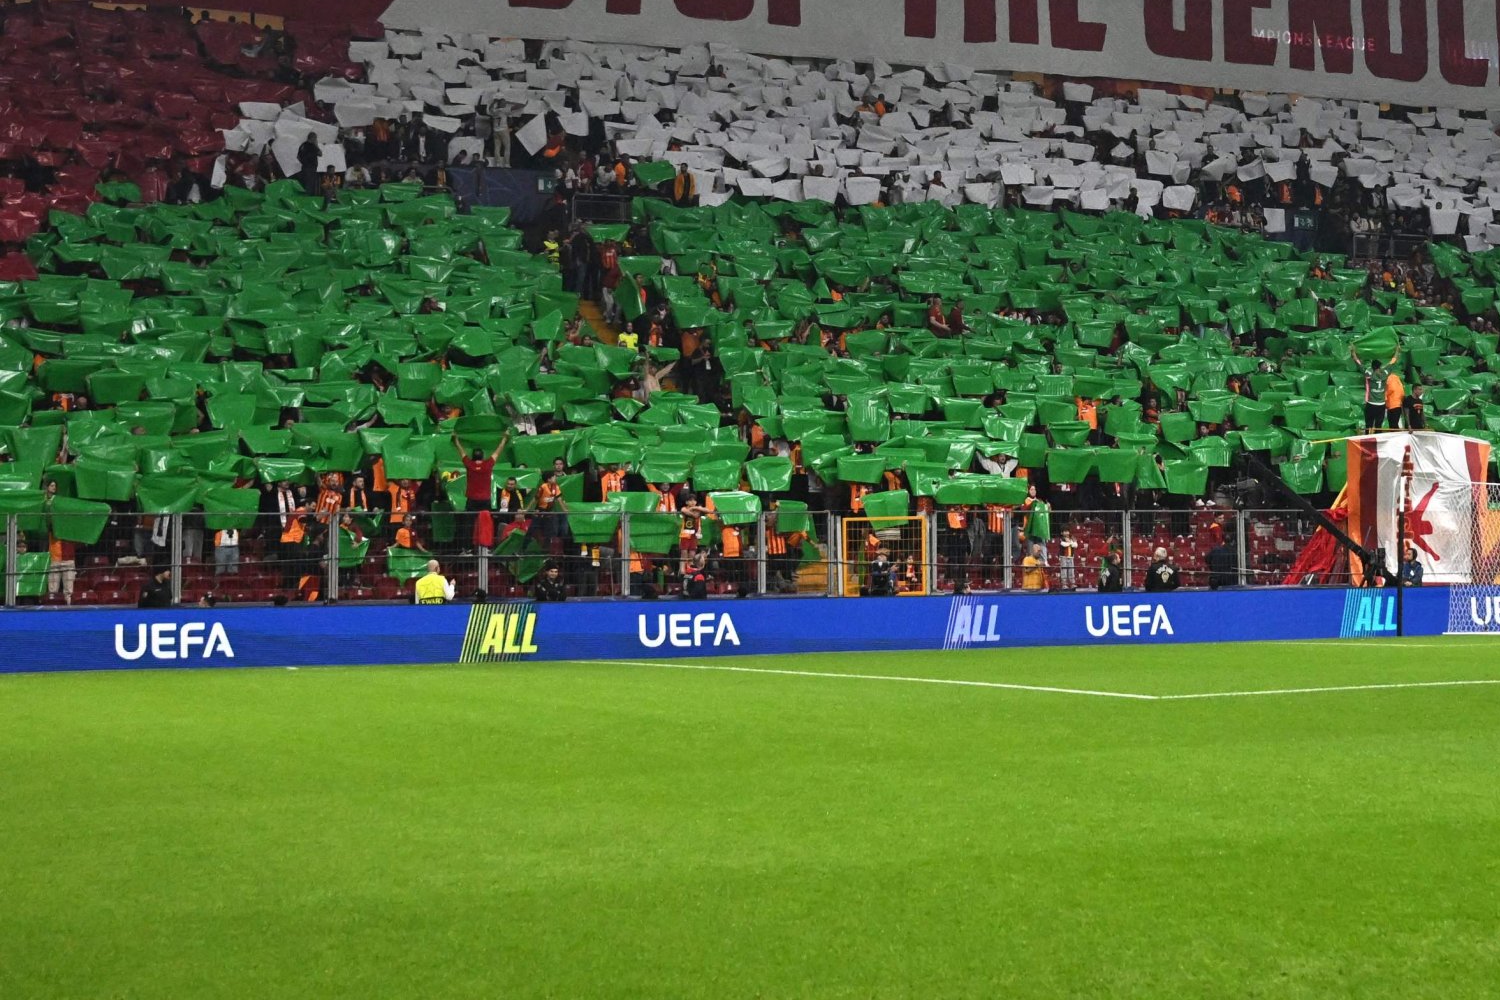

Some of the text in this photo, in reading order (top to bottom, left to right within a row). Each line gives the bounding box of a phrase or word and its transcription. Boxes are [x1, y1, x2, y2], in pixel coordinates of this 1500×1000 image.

[1317, 35, 1377, 53] LEAGUE
[637, 612, 741, 648] UEFA
[952, 604, 1000, 643] ALL
[1085, 603, 1174, 638] UEFA
[1353, 595, 1398, 632] ALL
[114, 622, 235, 660] UEFA
[480, 612, 538, 654] ALL
